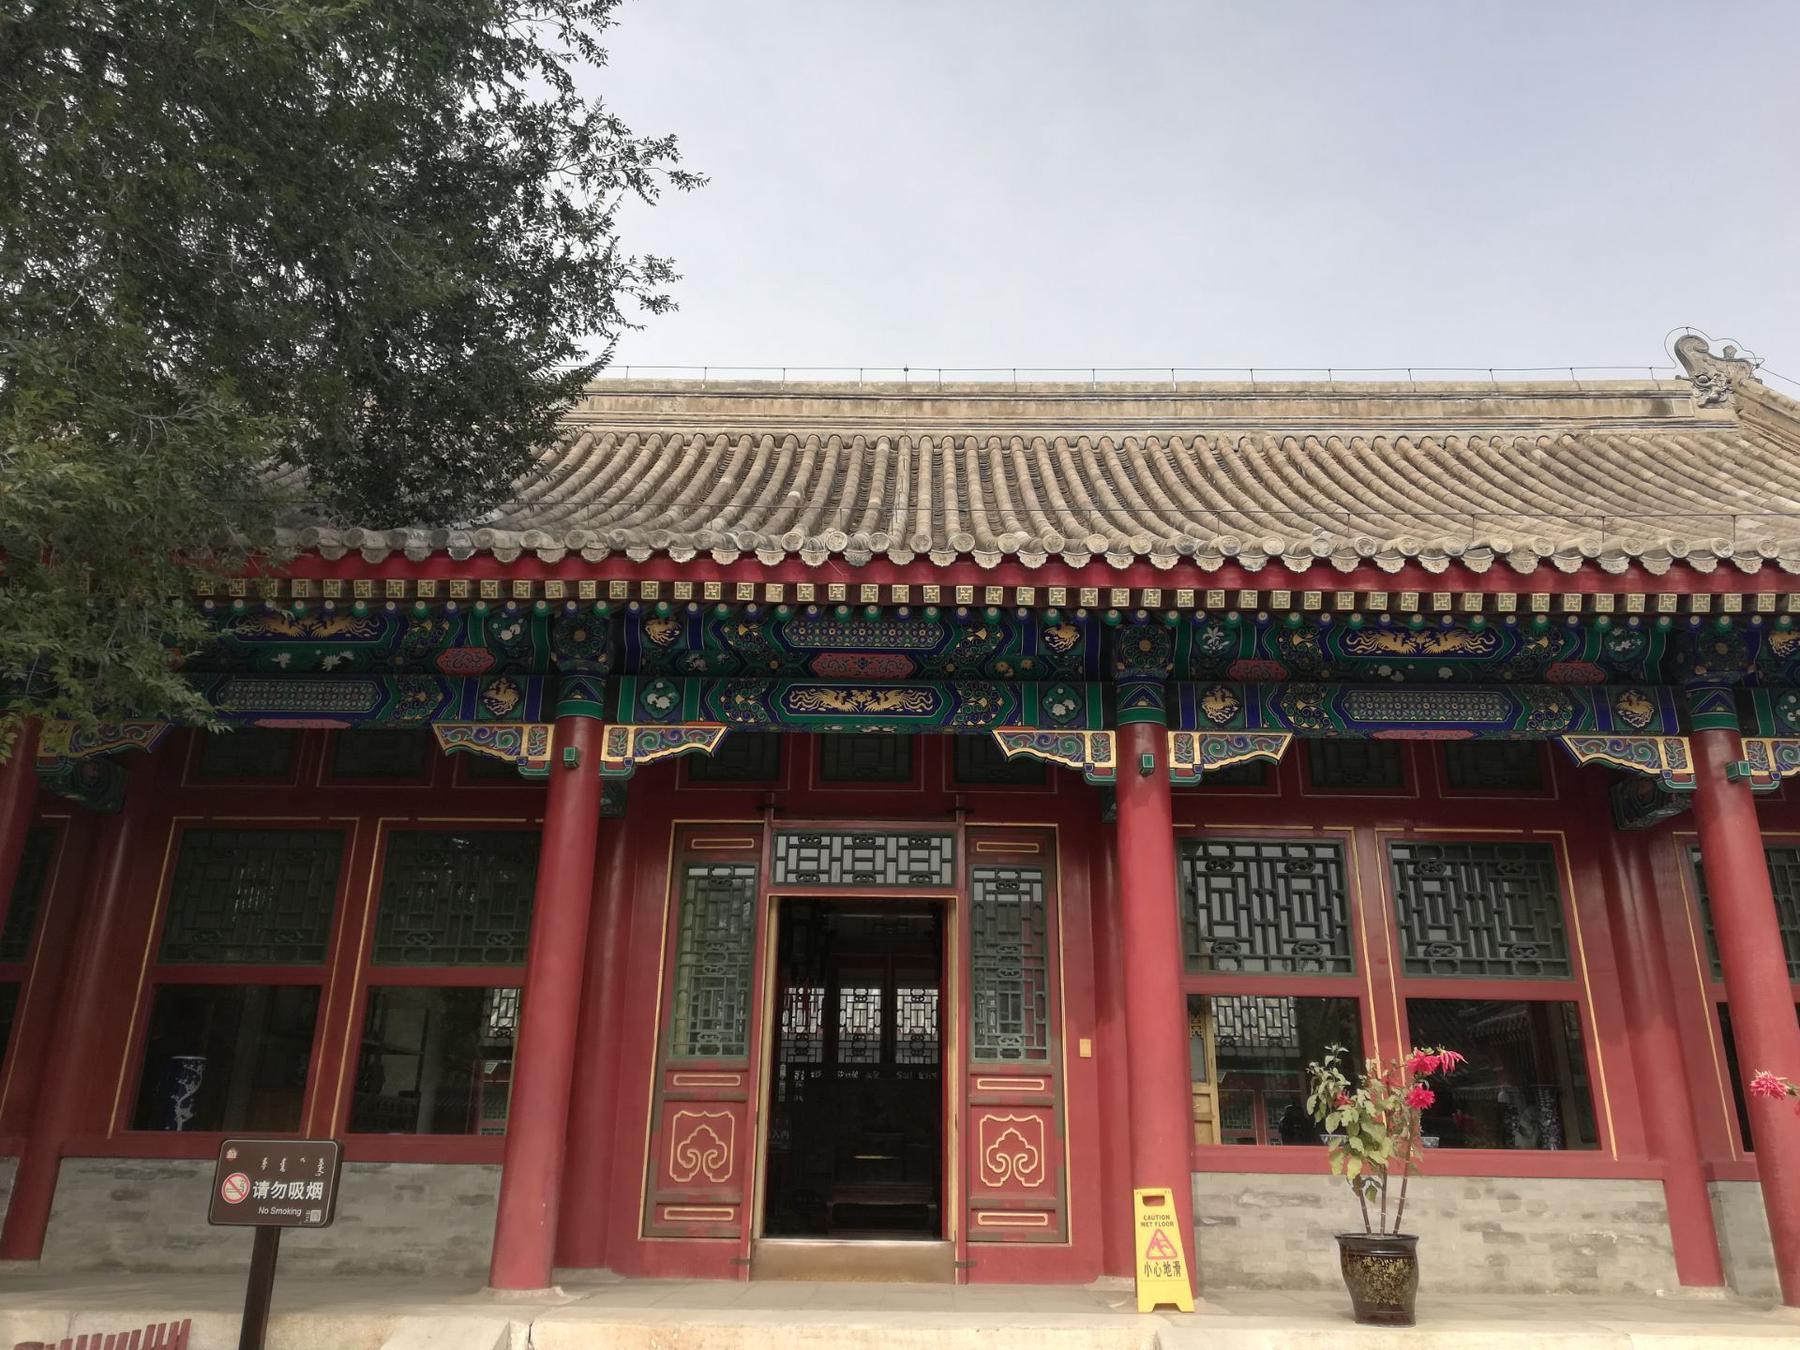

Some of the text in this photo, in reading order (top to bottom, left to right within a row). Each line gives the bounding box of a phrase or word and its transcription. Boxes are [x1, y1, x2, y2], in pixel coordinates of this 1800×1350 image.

[253, 1181, 324, 1200] 请勿吸烟
[258, 1206, 269, 1215] No
[271, 1206, 302, 1217] Smoking
[1144, 1261, 1181, 1277] 小心地滑
